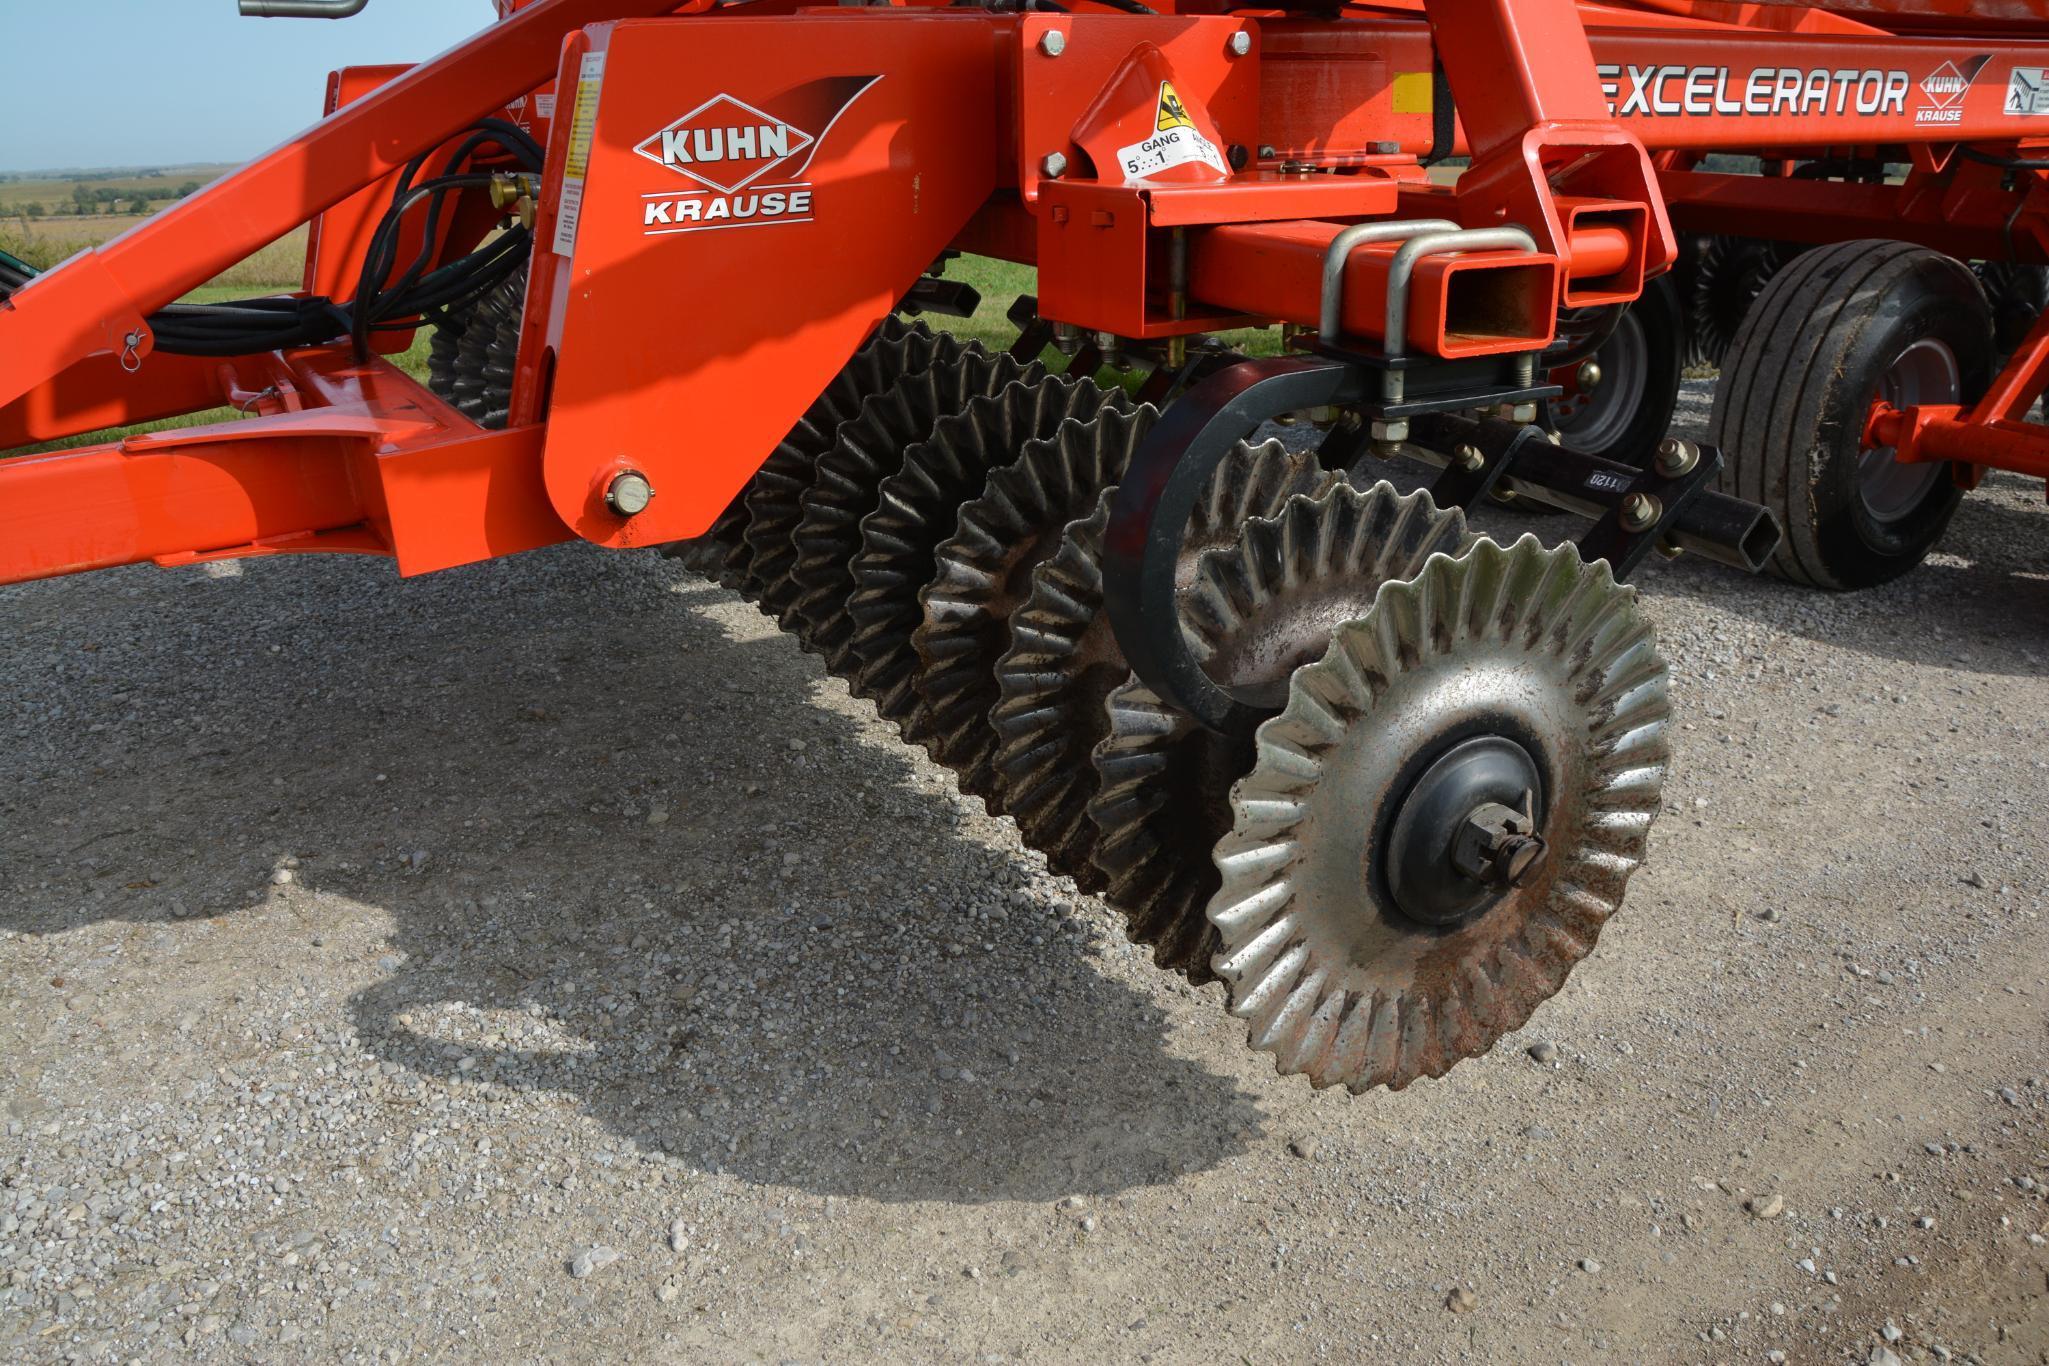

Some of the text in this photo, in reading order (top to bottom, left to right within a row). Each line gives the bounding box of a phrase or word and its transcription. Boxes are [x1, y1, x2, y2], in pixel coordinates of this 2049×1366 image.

[1926, 76, 1962, 93] KUHN
[1915, 110, 1962, 121] KRAUSE
[661, 124, 788, 165] KUHN
[1141, 132, 1180, 152] GANG
[644, 191, 812, 225] KRAUSE
[1590, 473, 1618, 489] 1120
